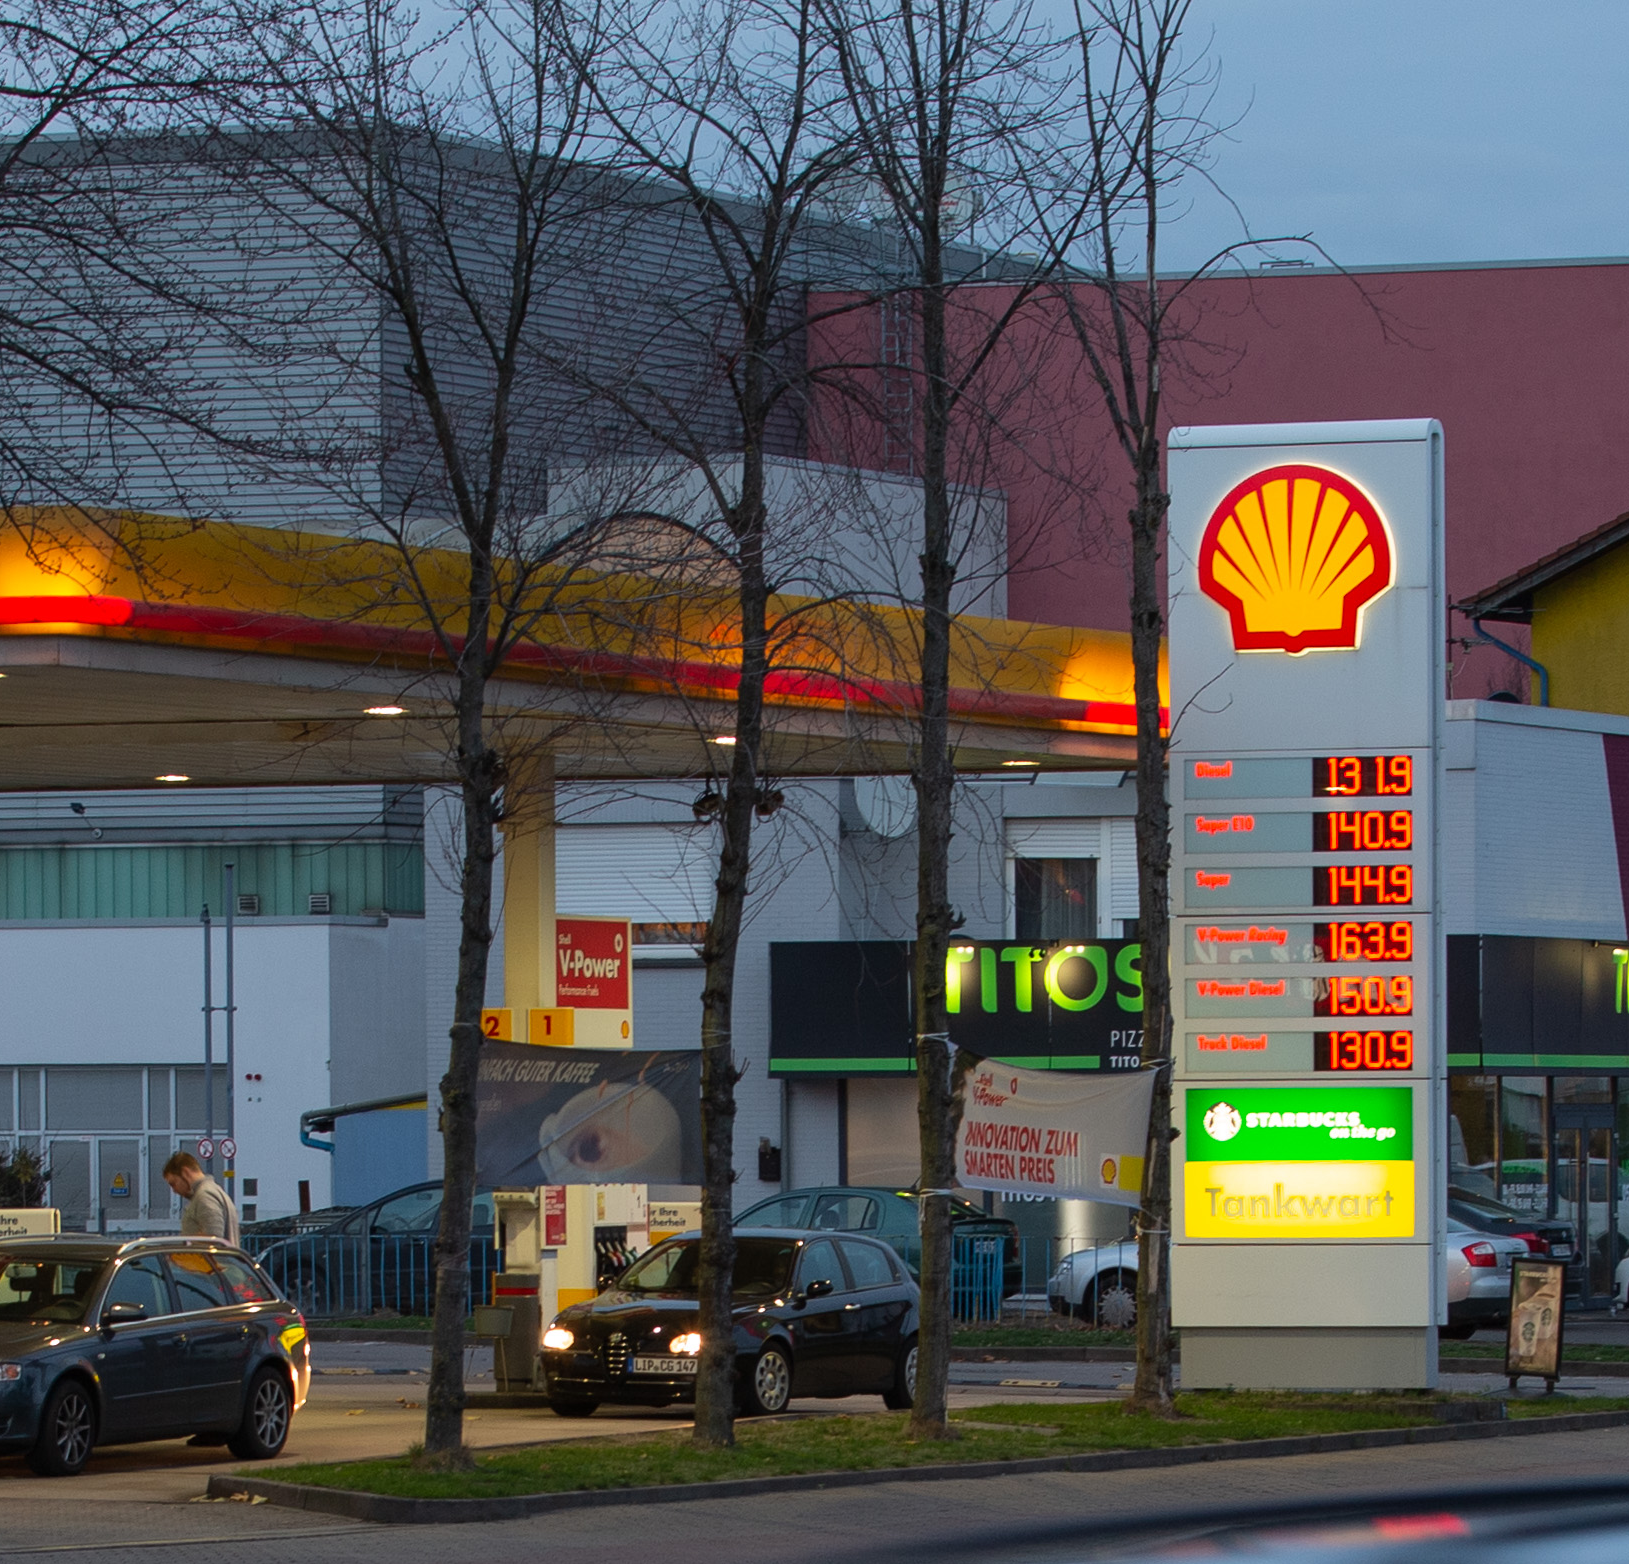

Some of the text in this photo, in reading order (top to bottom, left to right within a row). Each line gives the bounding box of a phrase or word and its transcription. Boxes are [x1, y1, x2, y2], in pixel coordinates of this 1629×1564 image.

[1194, 760, 1232, 778] Diesel
[1195, 810, 1413, 850] Super E10 140.9
[1195, 864, 1413, 905] Super 144.9
[558, 934, 572, 945] Shell
[1196, 921, 1413, 961] V-Power Racing 163.9
[559, 949, 621, 979] V-Power
[1196, 975, 1413, 1016] V-Power Diesel 150.9
[485, 1016, 500, 1037] 2
[543, 1015, 552, 1036] 1
[1110, 1030, 1144, 1048] PIZZ
[1196, 1030, 1413, 1070] Truck Diesel 130.9
[514, 1060, 553, 1082] GUTER
[553, 1061, 601, 1083] KAFFEE
[1245, 1111, 1361, 1128] STARBUCKS
[1044, 1130, 1080, 1157] ZUM
[1375, 1127, 1396, 1141] go
[964, 1150, 1056, 1185] SMARTEN PREIS
[1205, 1183, 1394, 1217] Tankwart
[659, 1207, 678, 1217] Ihre
[635, 1360, 696, 1372] LIP CG 147
